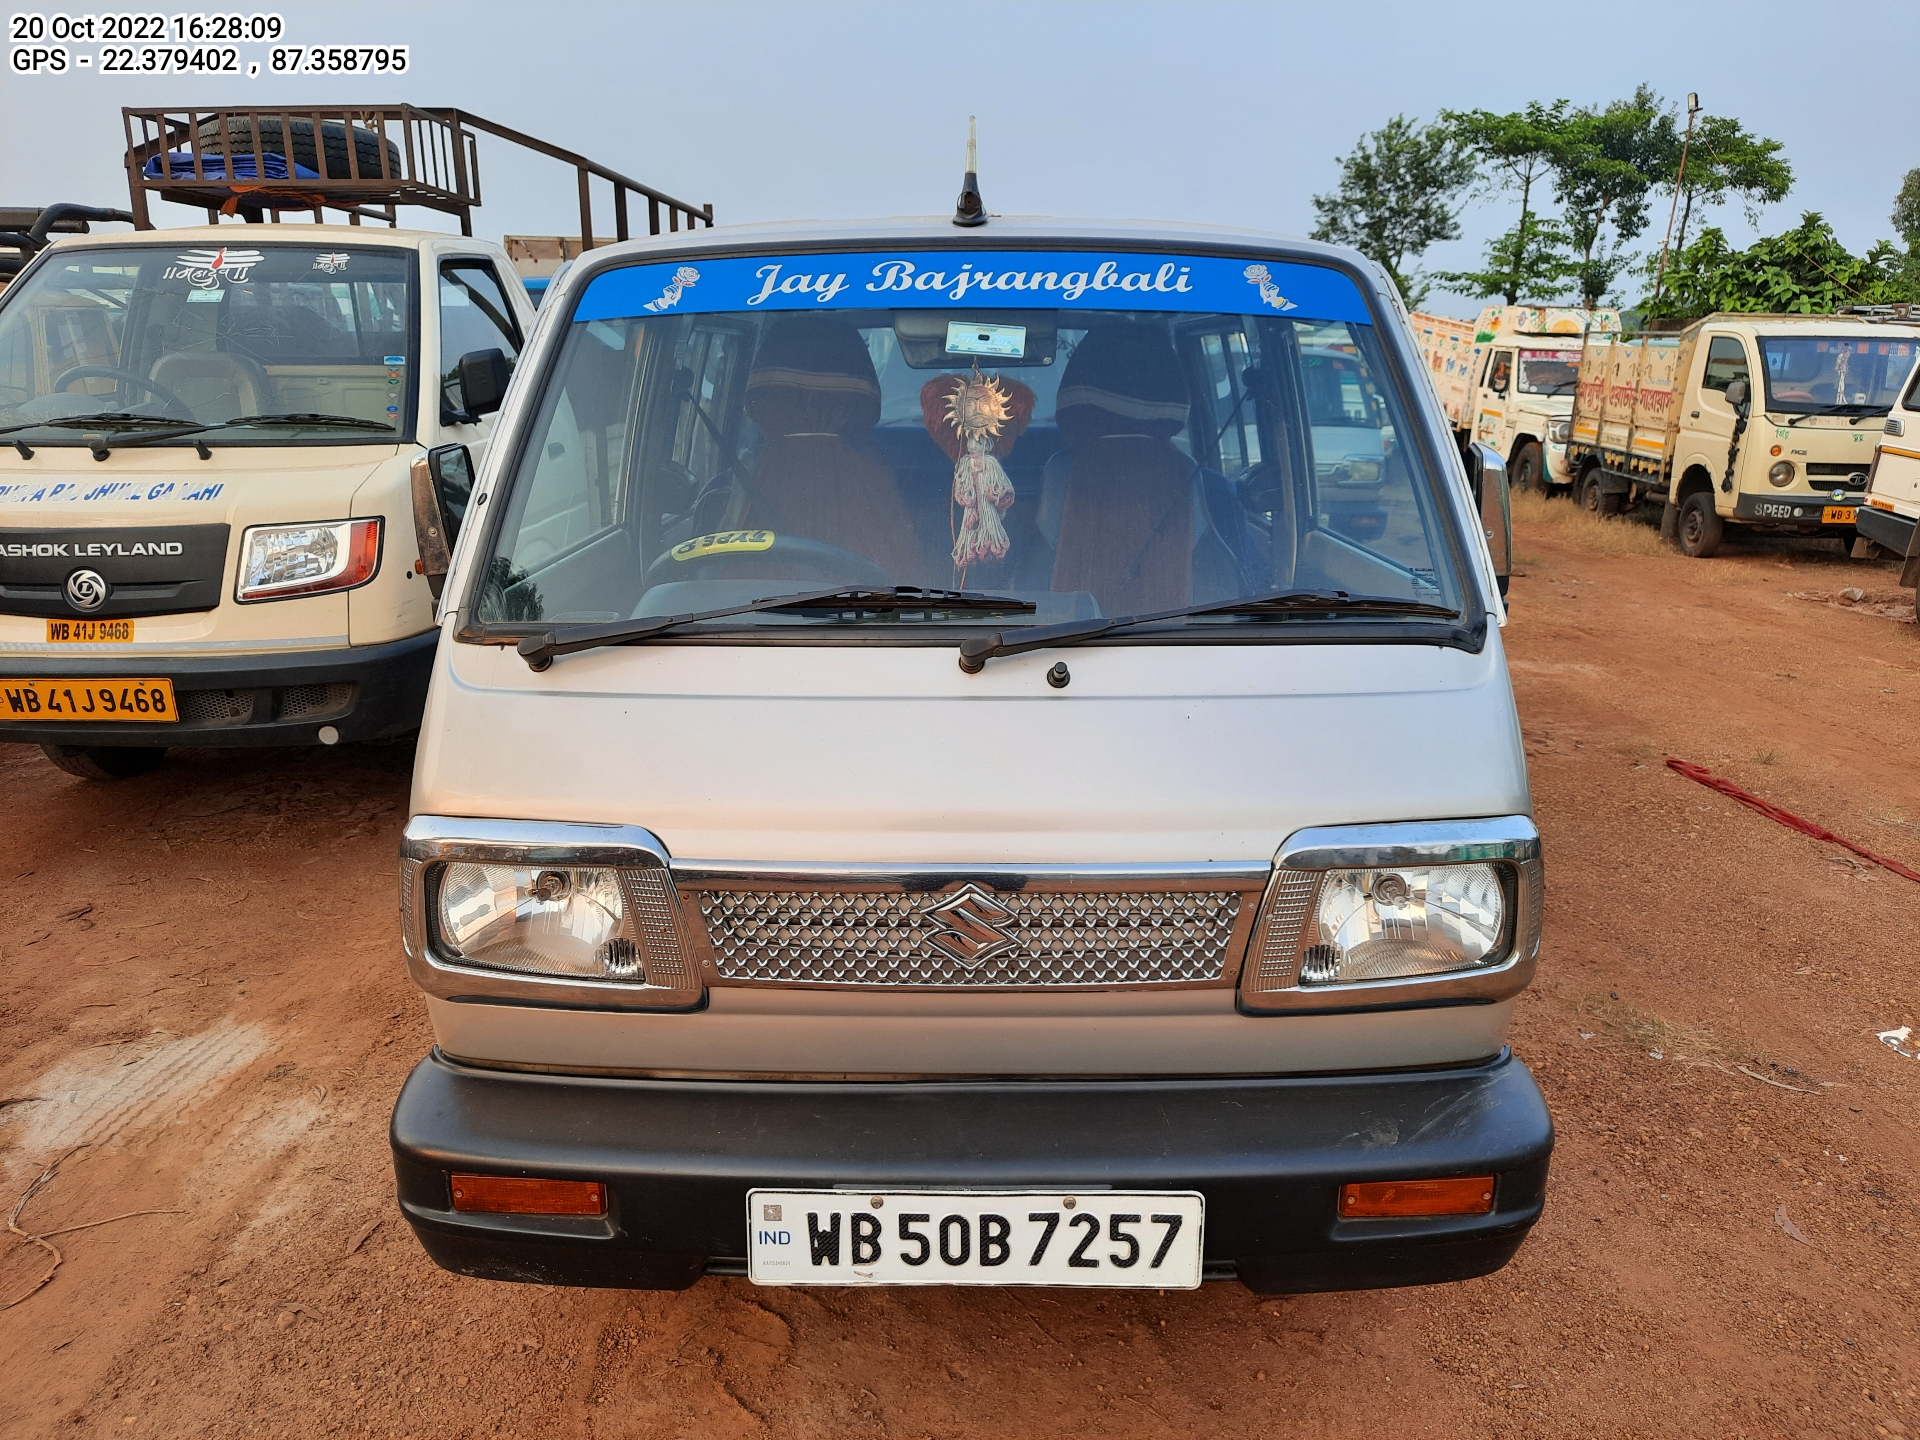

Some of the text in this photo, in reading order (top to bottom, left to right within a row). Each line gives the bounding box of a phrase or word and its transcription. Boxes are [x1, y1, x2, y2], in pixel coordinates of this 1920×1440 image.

[747, 259, 1193, 306] Jay Bajrangbali
[48, 483, 83, 501] RAJ
[83, 482, 150, 501] JHUKE
[147, 482, 176, 500] GA
[175, 482, 225, 501] NAHI
[1754, 503, 1791, 519] SPEED
[0, 542, 183, 557] ASHOK LEYLAND
[51, 622, 129, 640] WB 41J 9468
[759, 1230, 791, 1245] IND
